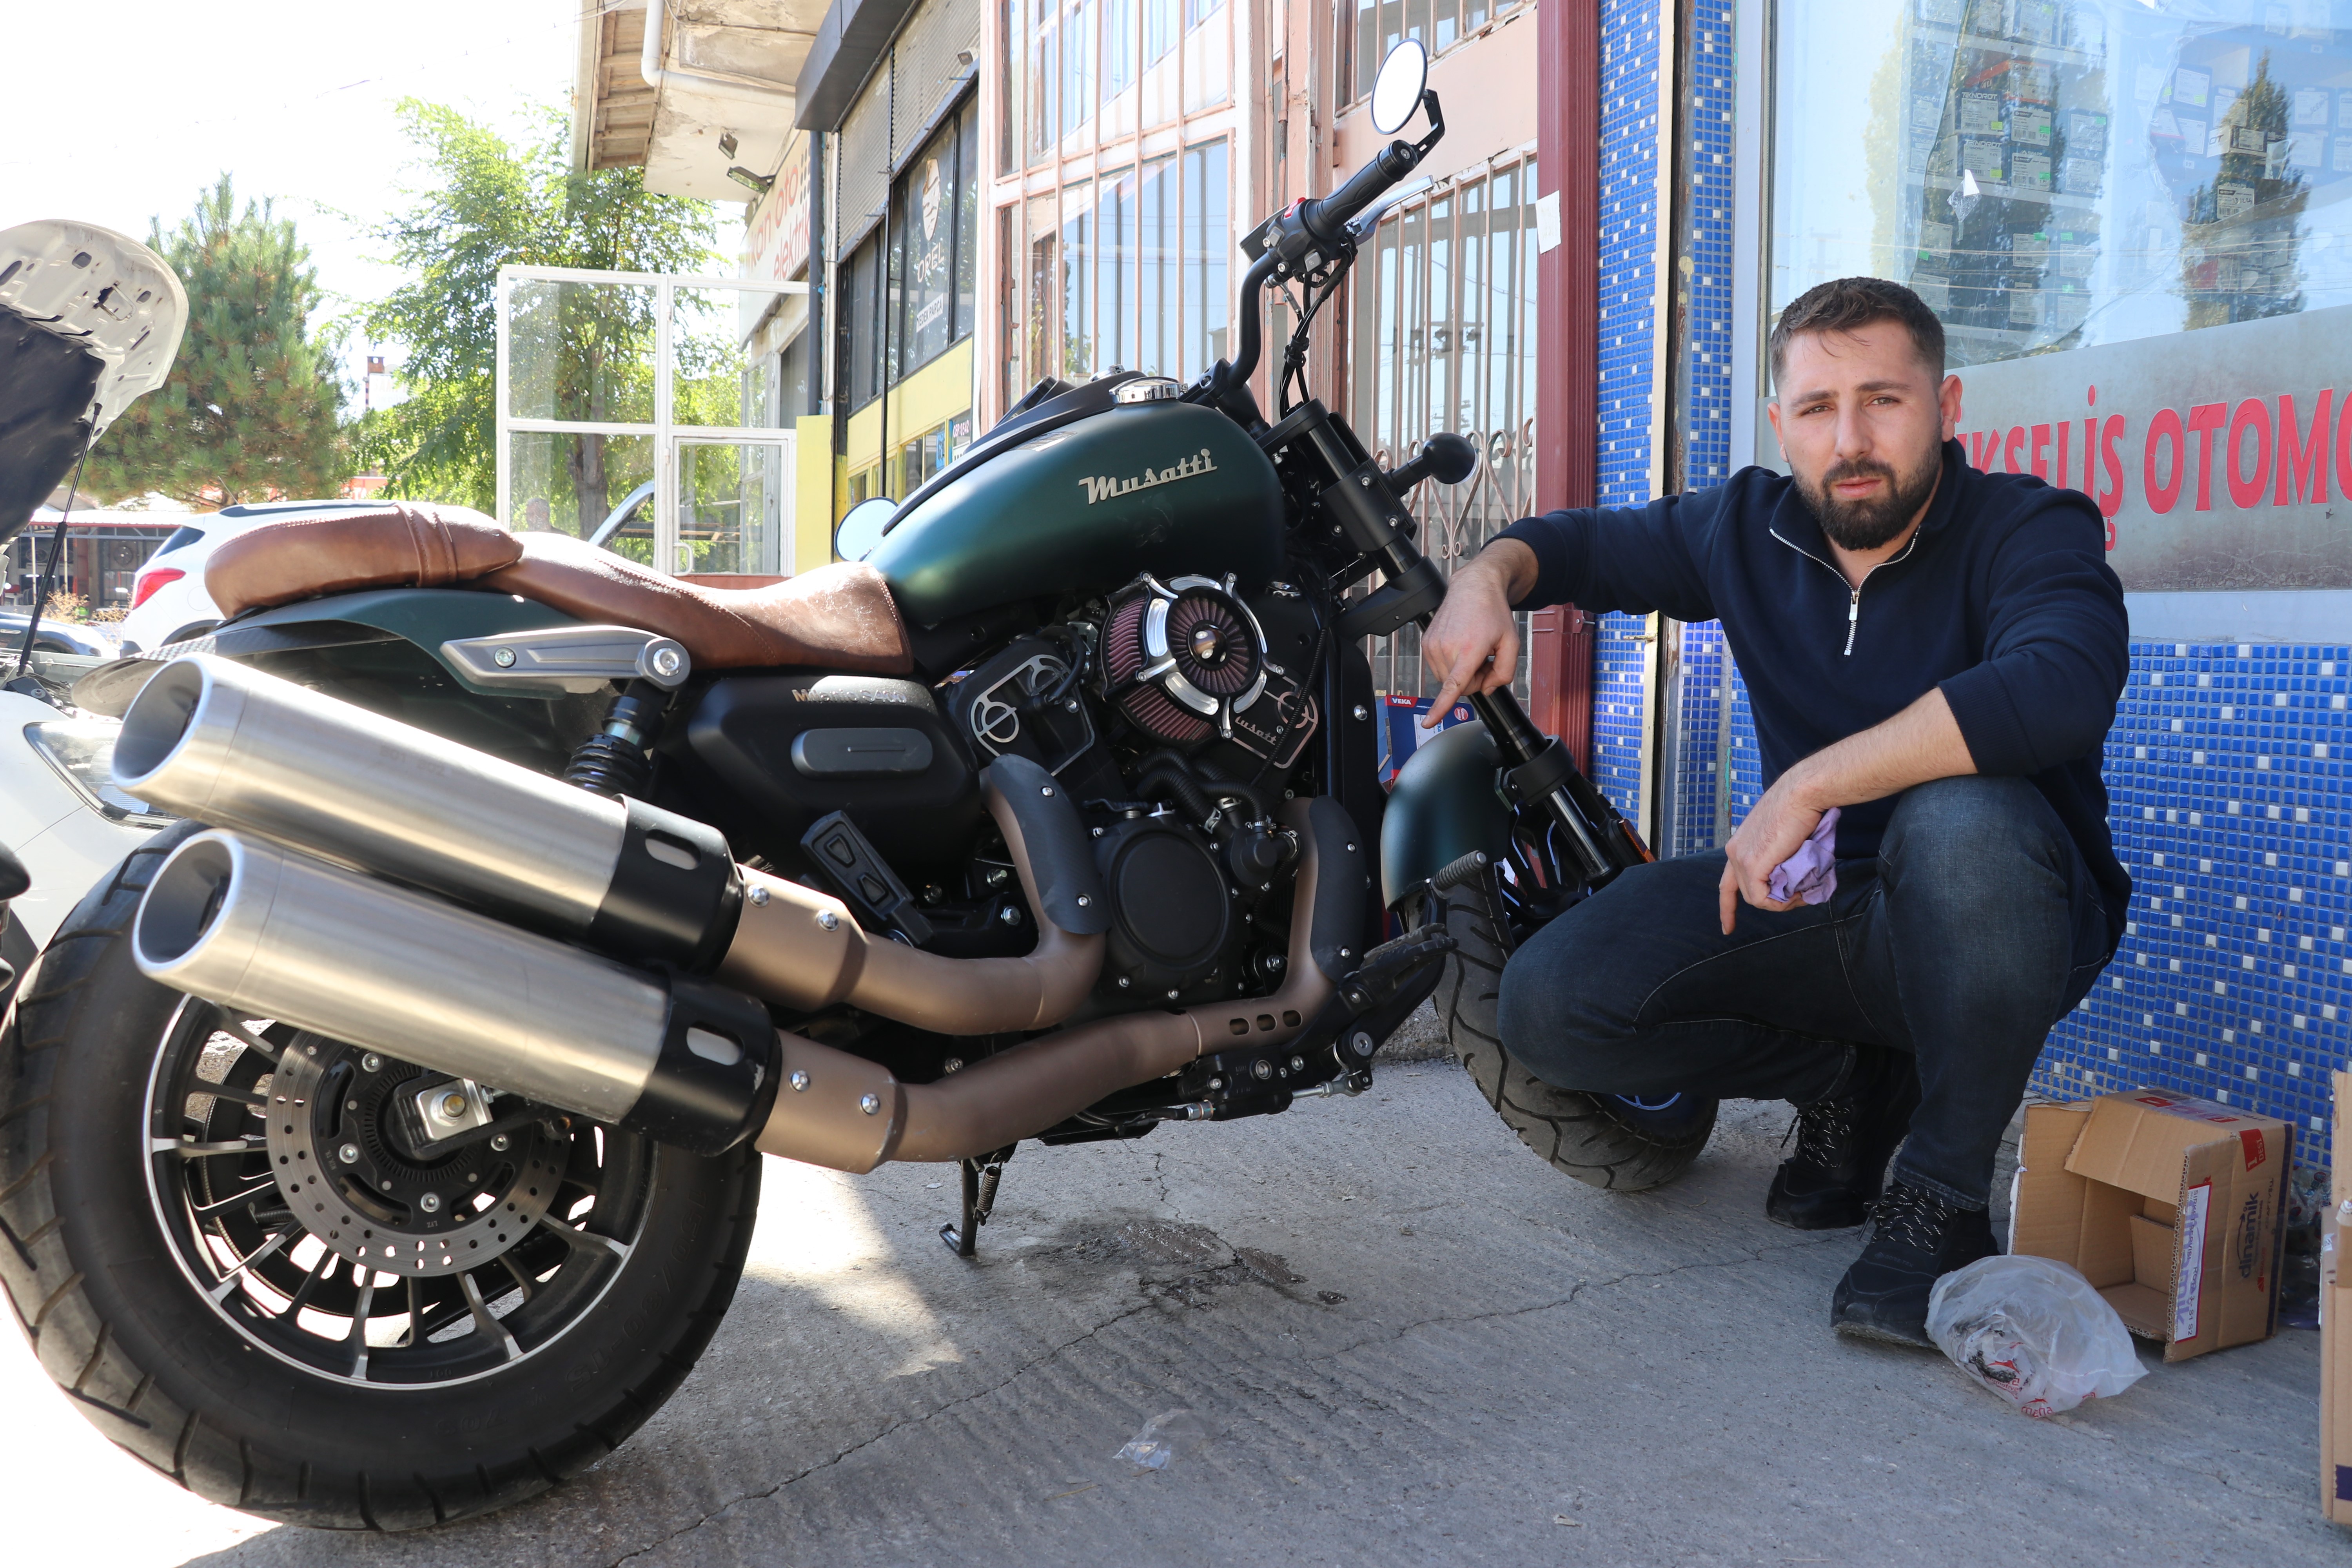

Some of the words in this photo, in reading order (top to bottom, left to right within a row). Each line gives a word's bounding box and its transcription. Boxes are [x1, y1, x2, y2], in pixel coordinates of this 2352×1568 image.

[1962, 92, 1998, 100] TEKNOROT
[775, 164, 798, 229] oto
[917, 242, 944, 283] OPEL
[1078, 448, 1218, 505] Musatti
[1959, 385, 2125, 550] KSELİŞ
[1235, 716, 1276, 745] usatt
[2248, 1157, 2258, 1168] 1
[2239, 1191, 2259, 1278] dinamik
